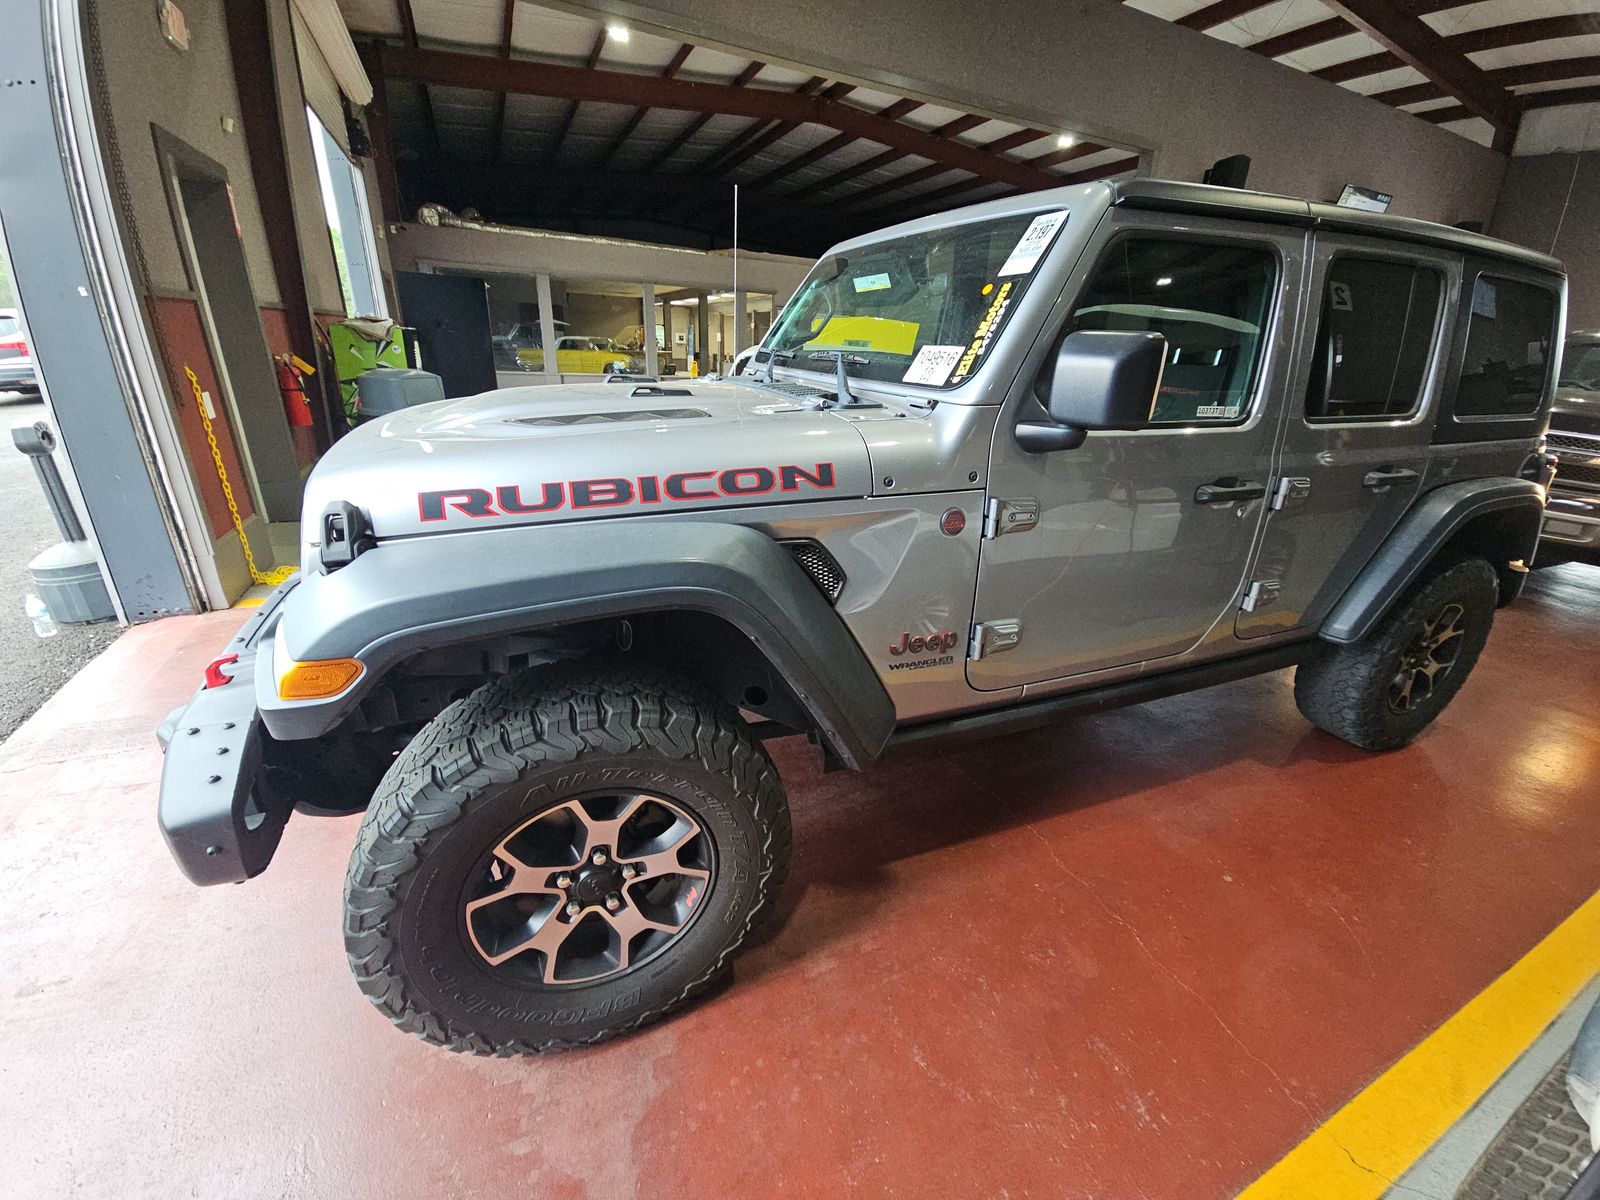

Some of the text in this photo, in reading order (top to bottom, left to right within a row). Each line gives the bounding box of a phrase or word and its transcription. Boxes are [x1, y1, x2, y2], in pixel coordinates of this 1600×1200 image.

[954, 281, 1013, 378] Elite Motors
[418, 462, 836, 522] RUBICON
[888, 631, 958, 656] Jeep
[888, 655, 954, 671] WRANGLER
